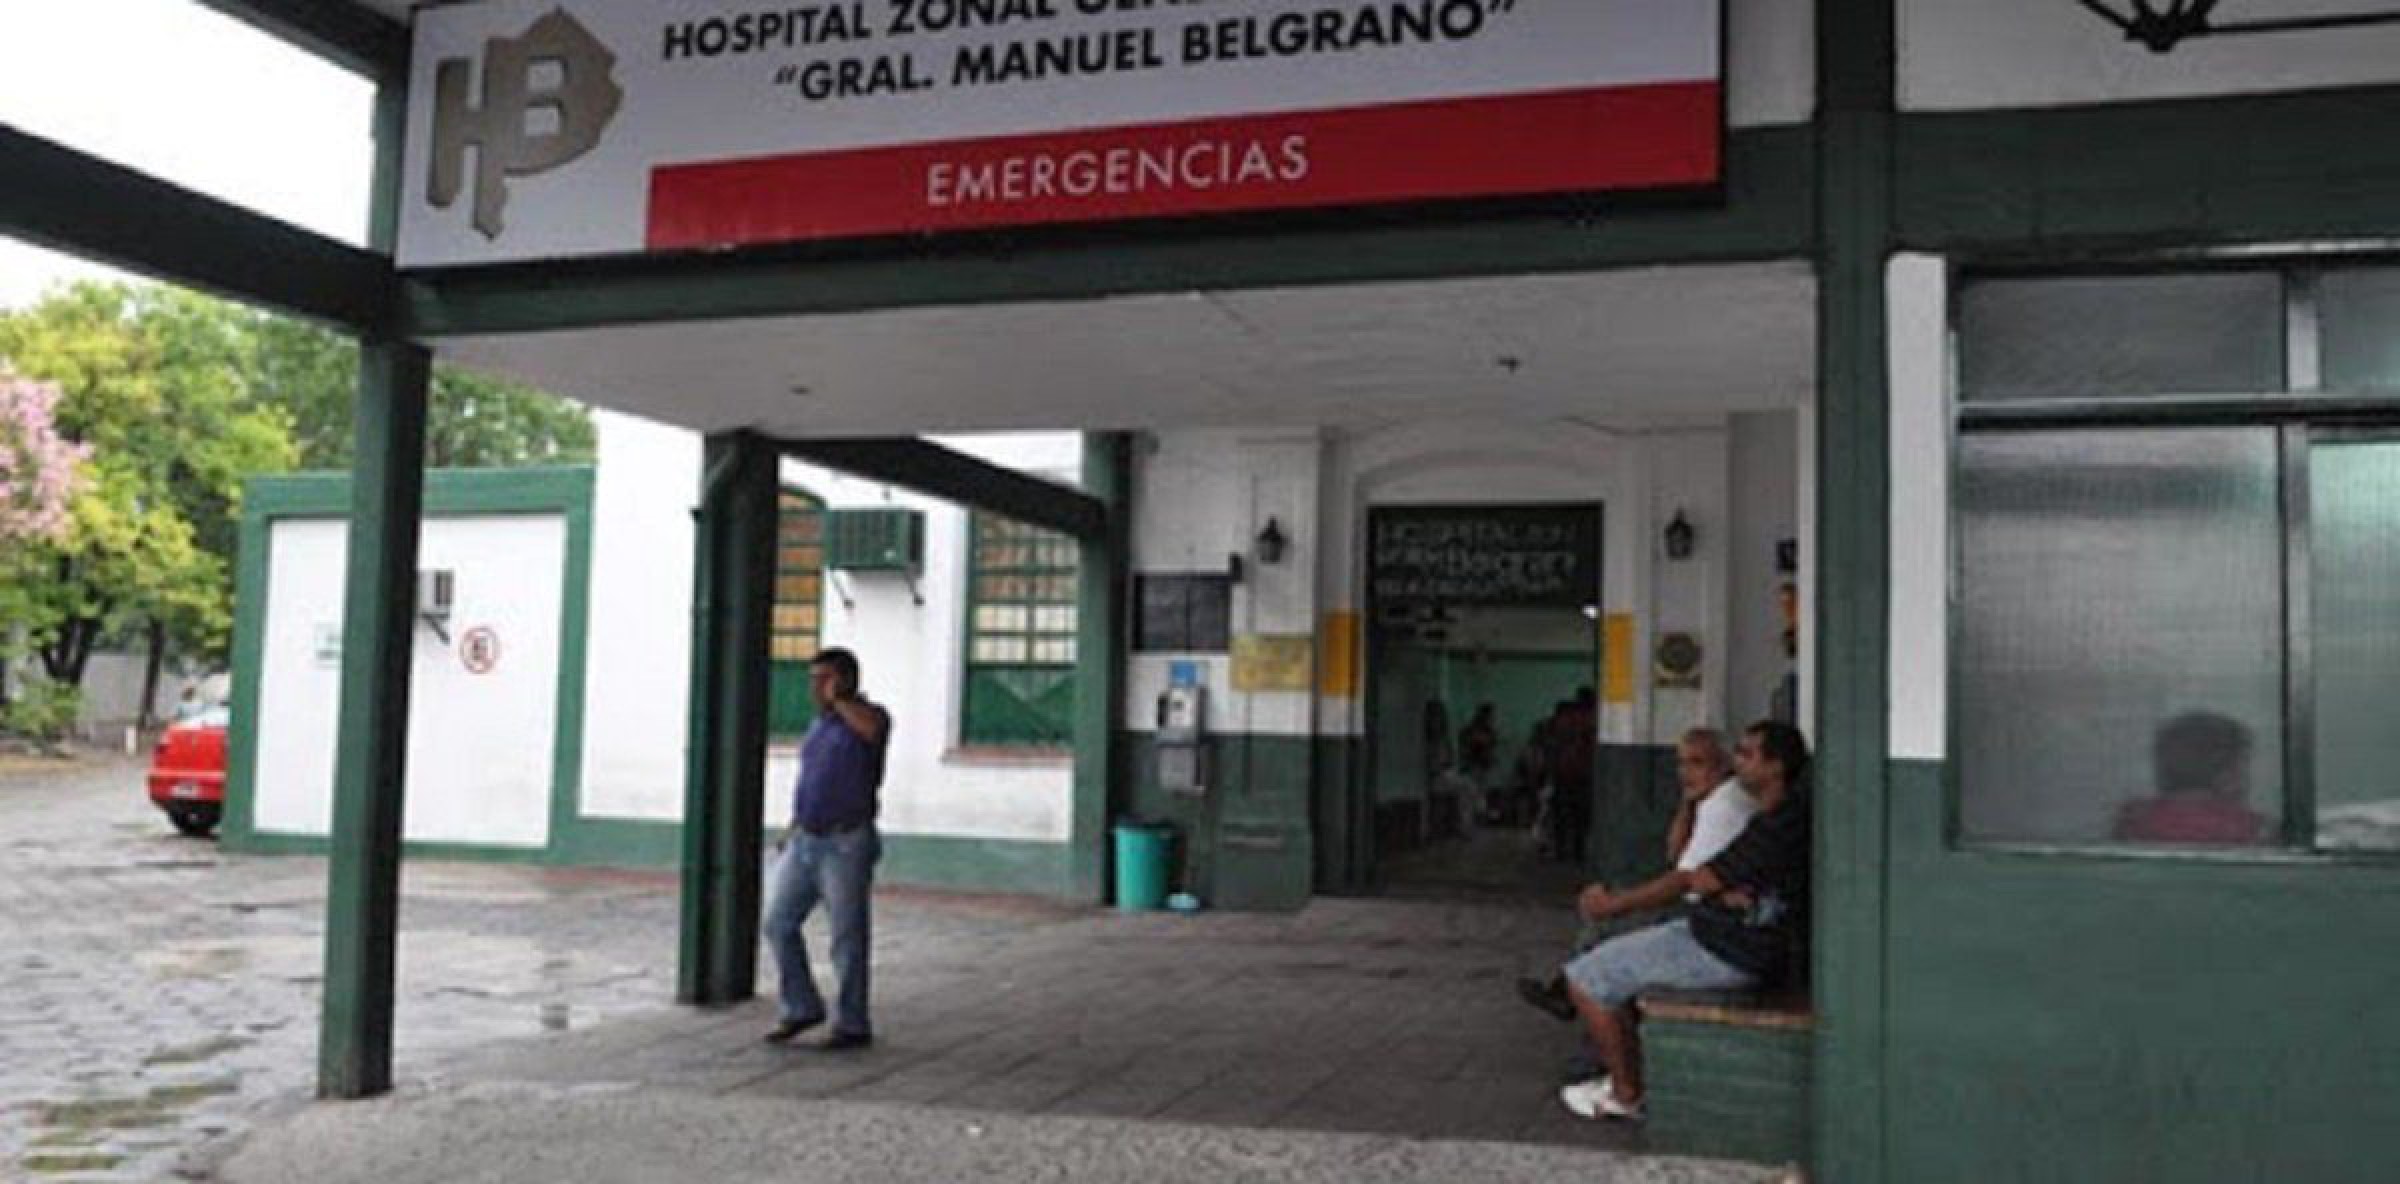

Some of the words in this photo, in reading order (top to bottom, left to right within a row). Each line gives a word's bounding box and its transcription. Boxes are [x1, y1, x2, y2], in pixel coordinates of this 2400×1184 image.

[662, 2, 871, 61] HOSPITAL
[950, 27, 1164, 87] MANUEL
[927, 134, 1310, 206] EMERGENCIAS
